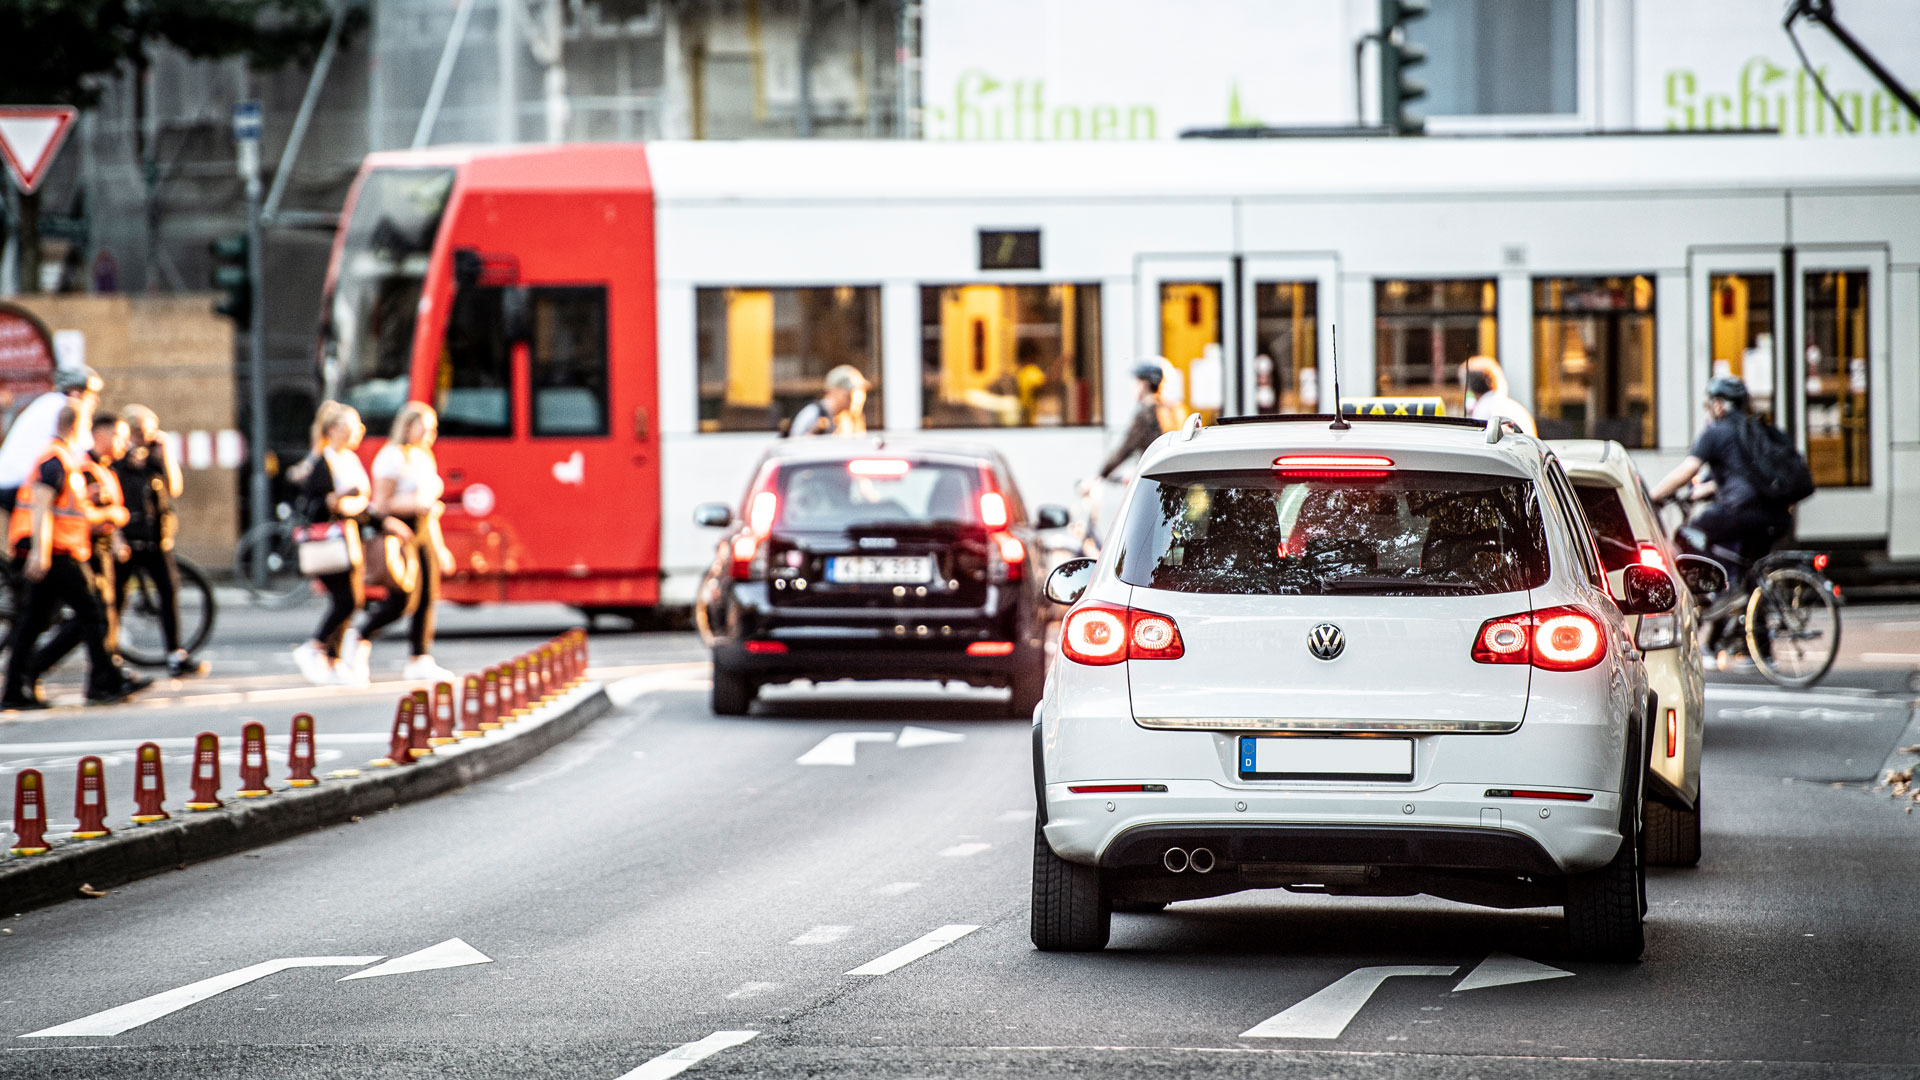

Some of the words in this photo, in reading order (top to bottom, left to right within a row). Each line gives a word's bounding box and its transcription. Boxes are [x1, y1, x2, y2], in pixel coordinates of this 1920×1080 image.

[1351, 402, 1424, 416] TAXI
[1308, 622, 1345, 660] VW
[1245, 758, 1252, 767] D
